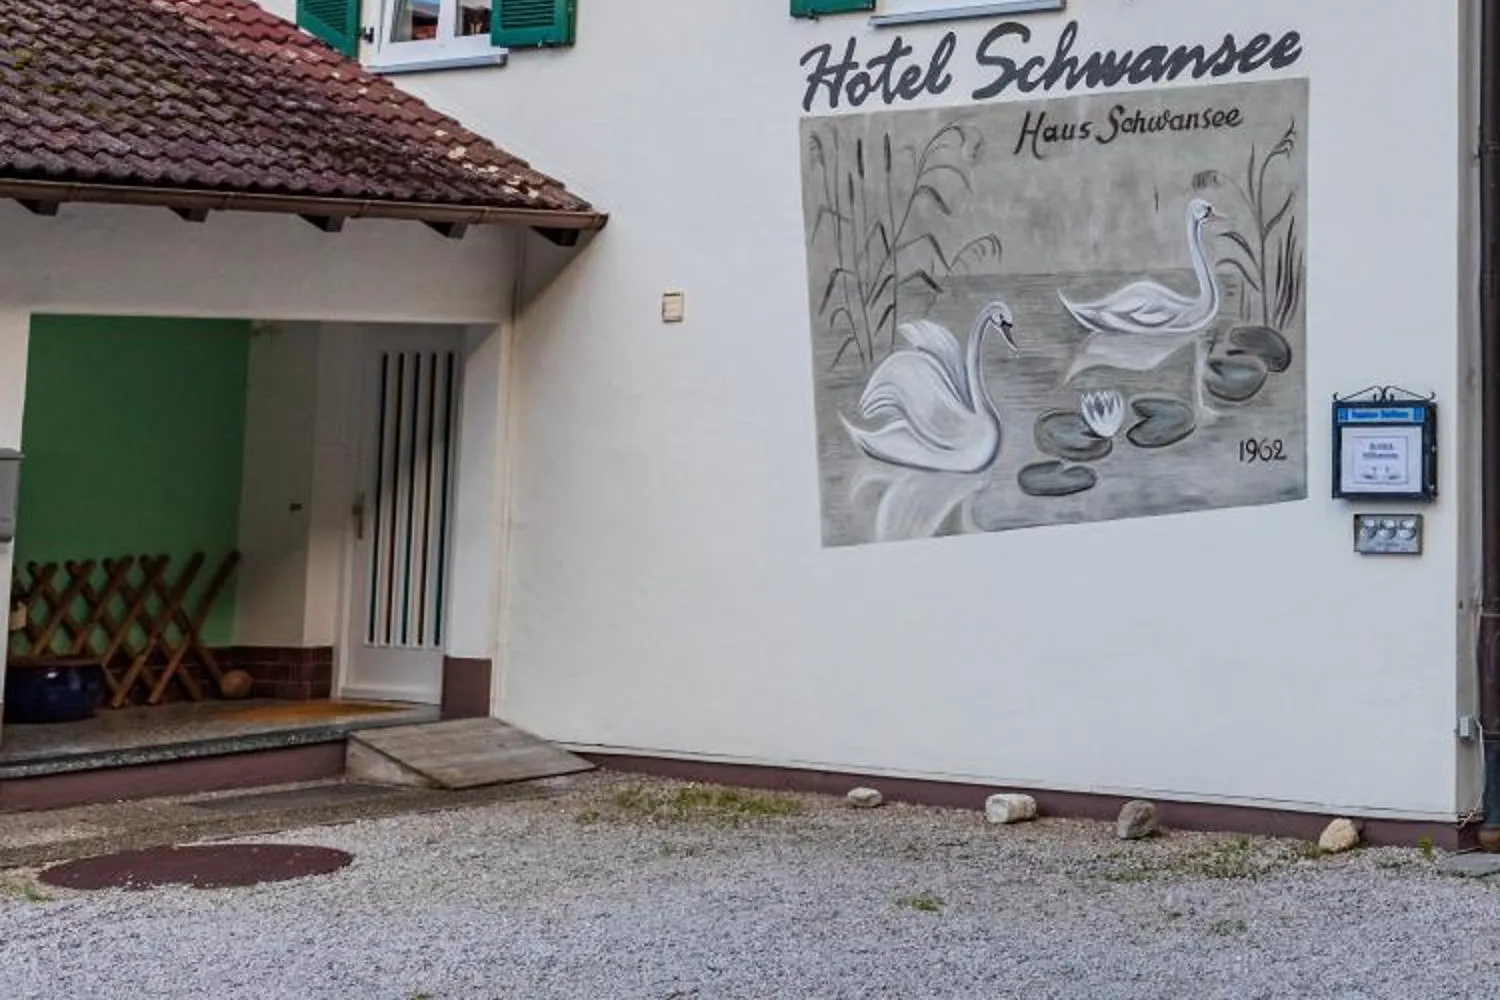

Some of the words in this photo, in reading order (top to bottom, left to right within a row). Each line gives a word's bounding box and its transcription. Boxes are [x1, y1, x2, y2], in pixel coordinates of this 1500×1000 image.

[799, 31, 957, 112] Hotel
[971, 21, 1303, 100] Schwansee
[1013, 111, 1090, 160] Haus
[1096, 104, 1243, 144] Schwansee
[1239, 437, 1287, 464] 1962
